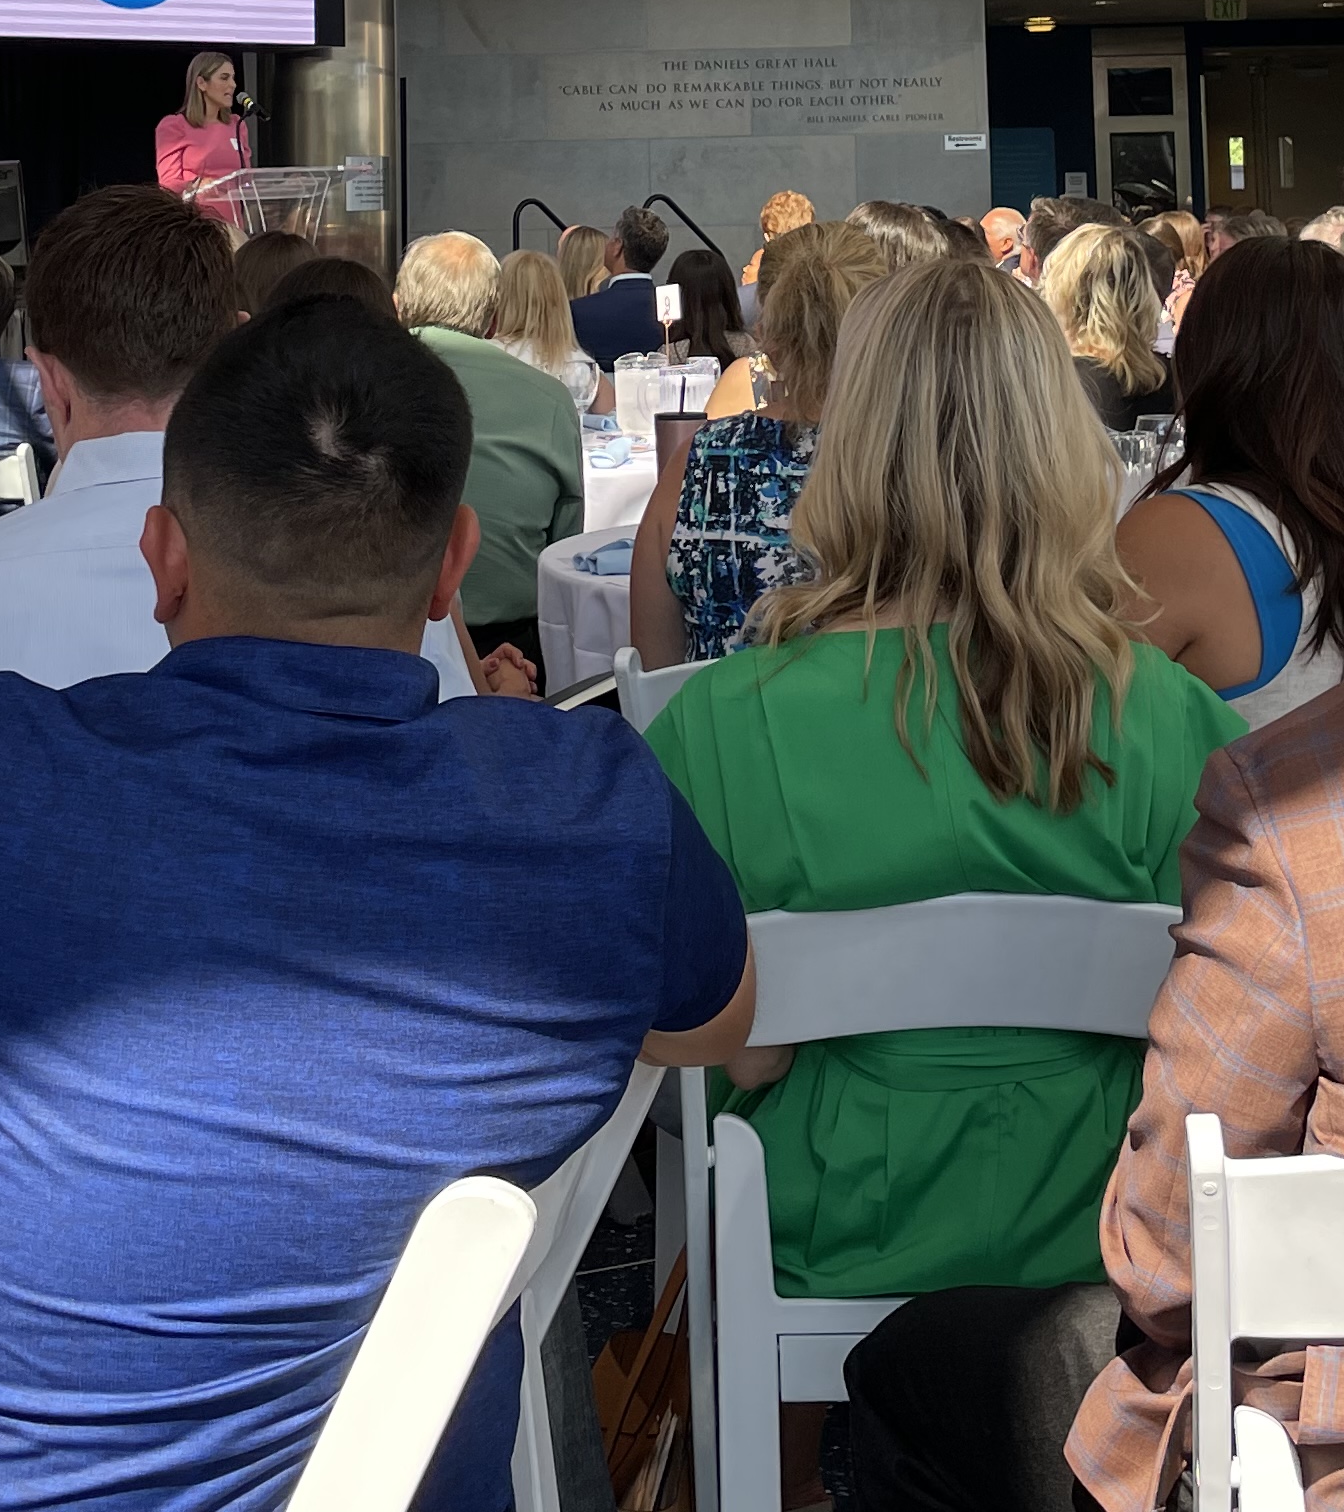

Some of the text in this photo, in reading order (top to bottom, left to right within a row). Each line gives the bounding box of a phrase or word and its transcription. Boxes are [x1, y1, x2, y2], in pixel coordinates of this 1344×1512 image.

[1213, 0, 1241, 18] EXIT
[662, 57, 838, 71] THE DANIELS GREAT HALL
[609, 84, 638, 95] CAN
[646, 83, 667, 94] DO
[673, 81, 765, 93] REMARKABLE
[829, 79, 854, 89] BUT
[860, 78, 888, 88] NOT
[893, 77, 943, 88] NEARLY
[599, 101, 614, 112] AS
[620, 100, 661, 111] MUCH
[668, 99, 684, 110] AS
[688, 99, 709, 109] WE
[715, 98, 745, 109] CAN
[752, 97, 773, 108] DO
[778, 97, 803, 107] FOR
[809, 95, 844, 106] EACH
[872, 113, 900, 122] CABLE
[905, 113, 944, 121] PIONEER
